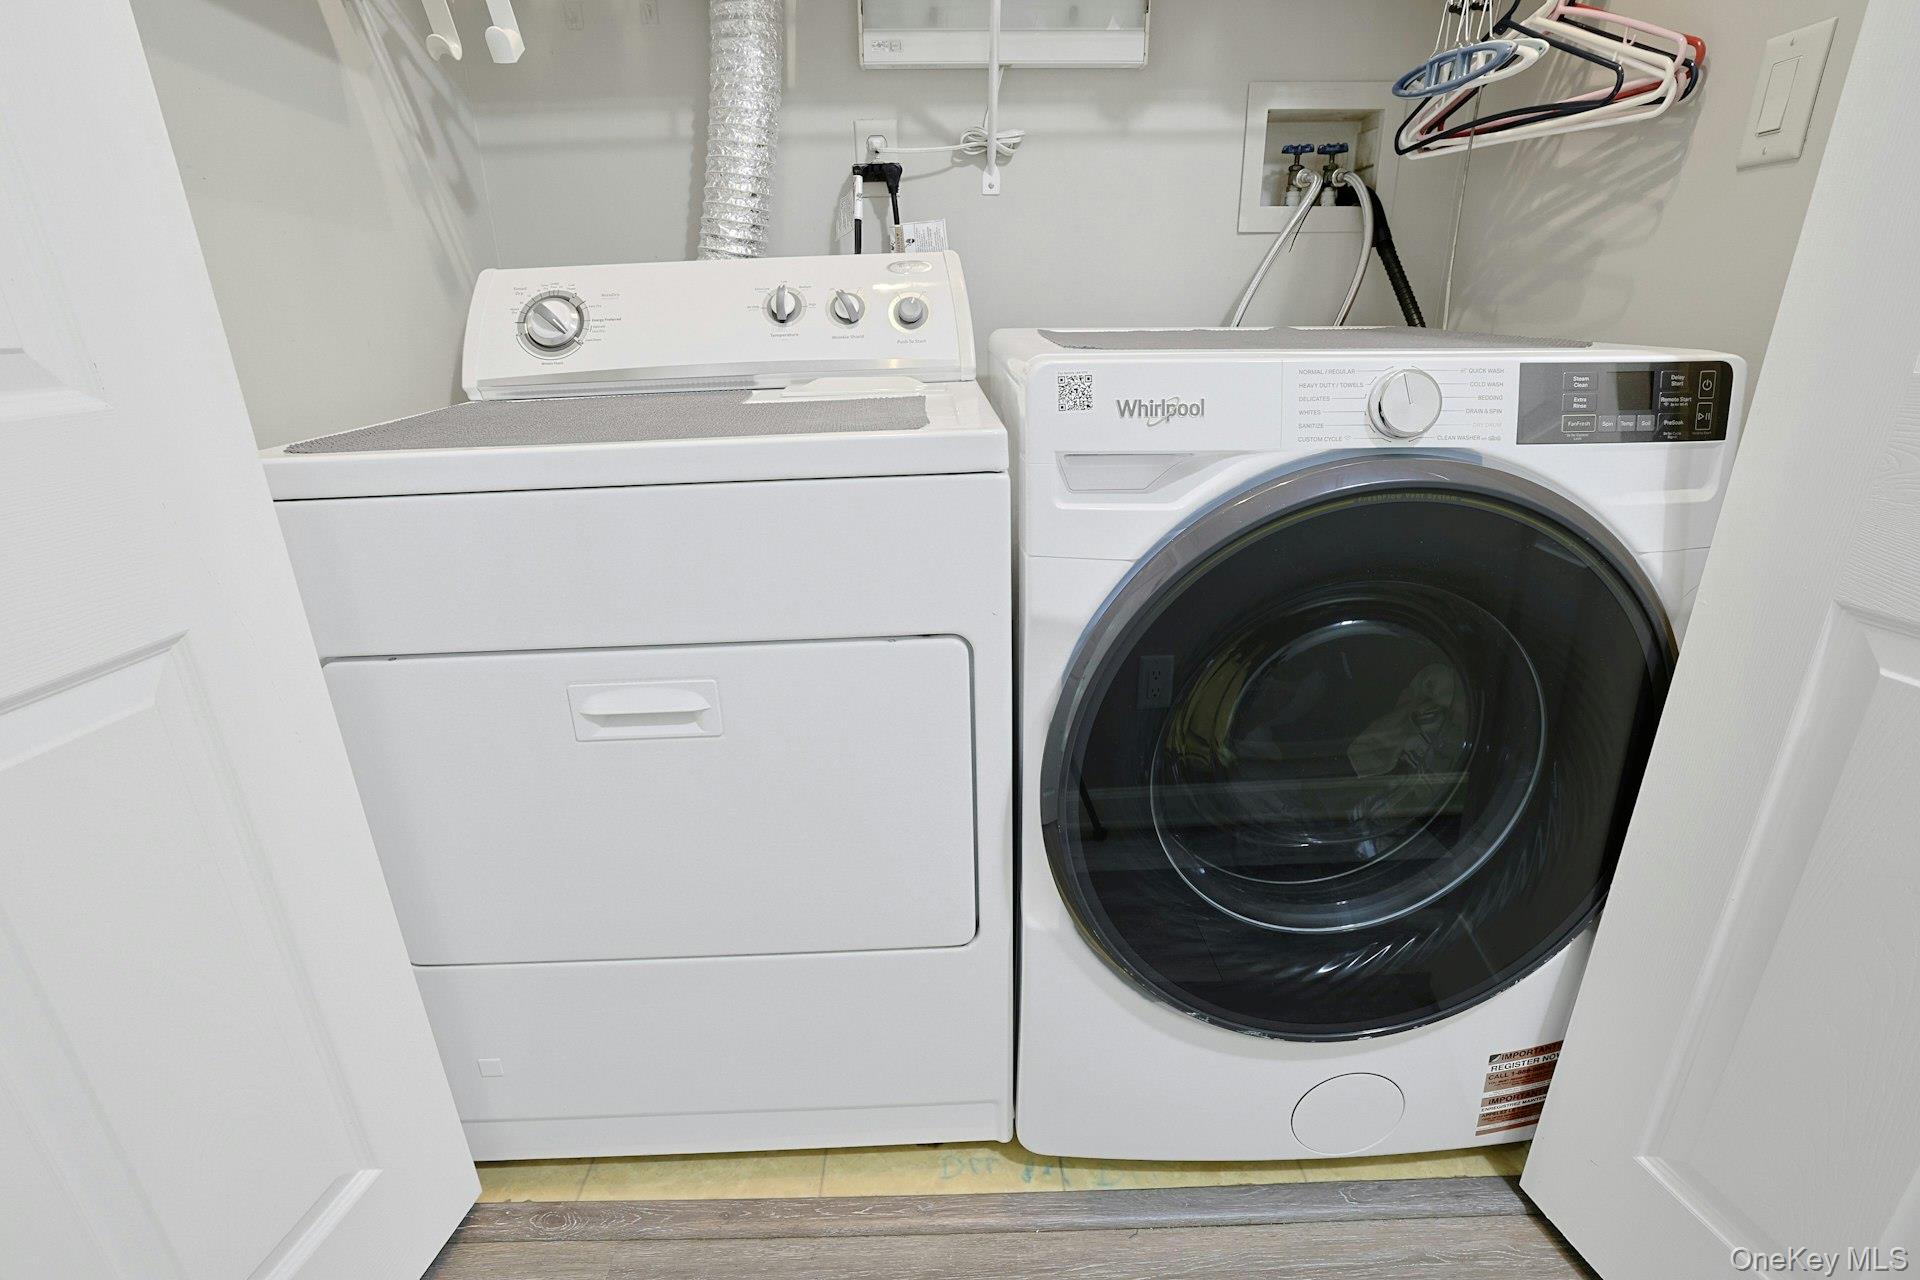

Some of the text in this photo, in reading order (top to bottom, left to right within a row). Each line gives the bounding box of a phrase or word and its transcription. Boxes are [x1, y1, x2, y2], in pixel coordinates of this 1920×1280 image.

[1116, 398, 1205, 422] Whirlpool
[1490, 1057, 1540, 1072] REGISTER
[1488, 1072, 1509, 1081] CALL
